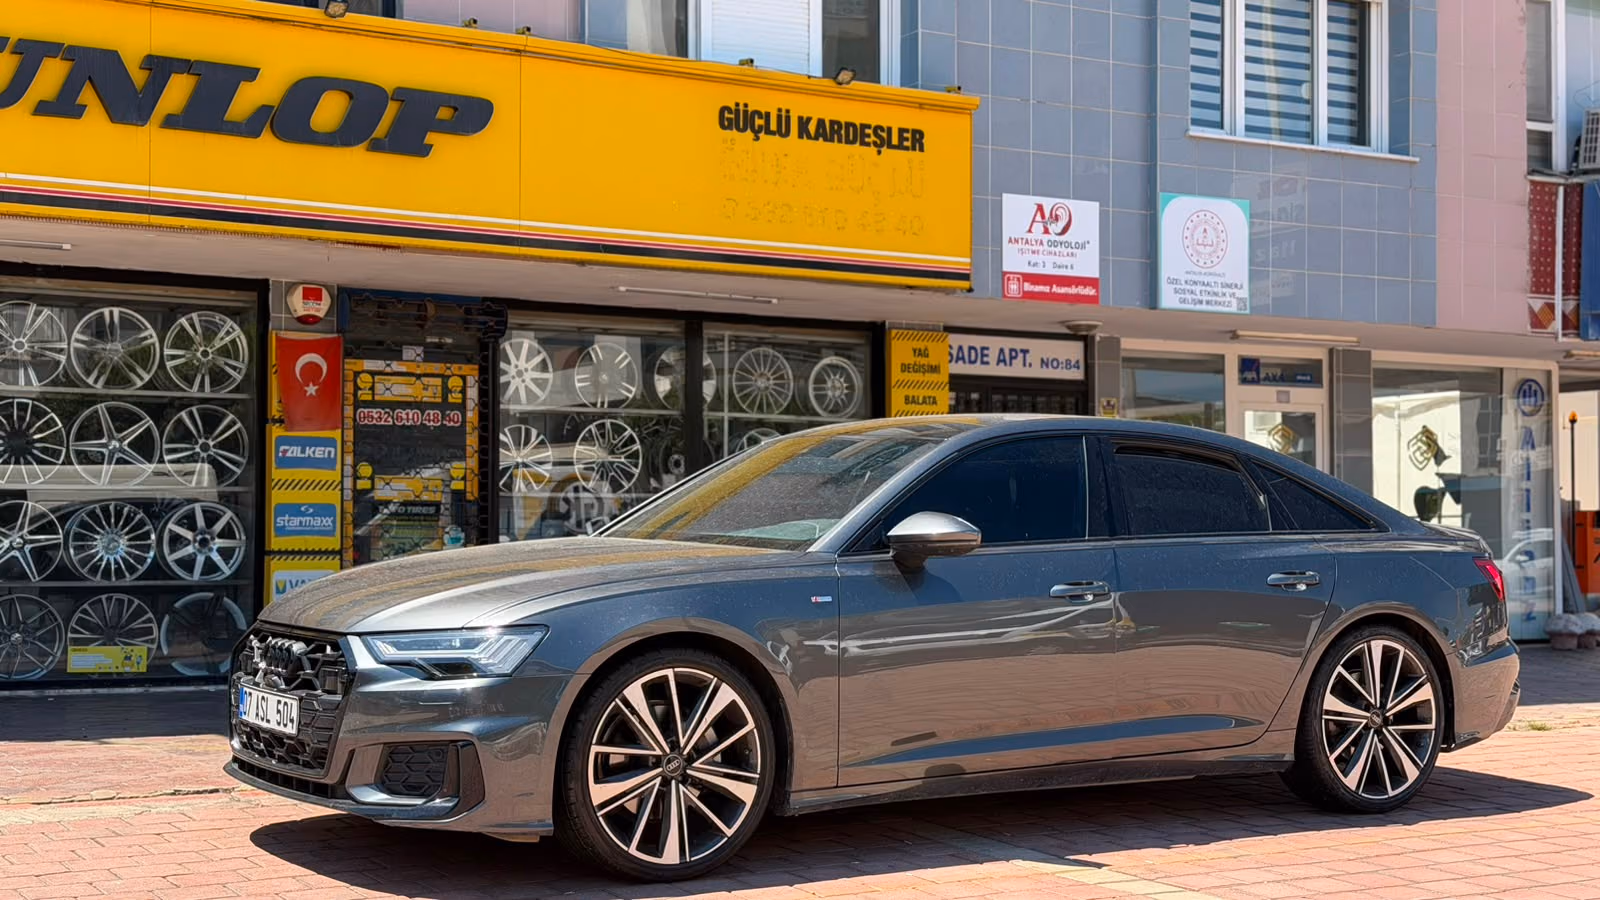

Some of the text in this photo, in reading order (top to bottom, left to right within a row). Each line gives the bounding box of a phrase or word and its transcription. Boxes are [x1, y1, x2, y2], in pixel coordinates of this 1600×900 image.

[718, 102, 925, 155] GÜÇLÜ KARDEŞLER
[1008, 237, 1044, 248] ANTALYA
[1166, 276, 1244, 290] ÖZEL KONYAALTI SİNERJİ
[1173, 287, 1198, 296] SOSYAL
[1199, 288, 1227, 298] ETKİNLİK
[1178, 297, 1204, 306] GELİŞİM
[912, 345, 930, 358] YAĞ
[996, 347, 1033, 368] APT.
[1040, 357, 1081, 371] NO:84
[900, 360, 941, 377] DEĞİŞİMİ
[904, 394, 938, 406] BALATA
[357, 408, 393, 425] 0532
[394, 409, 421, 426] 610
[423, 410, 441, 427] 48
[279, 445, 335, 459] FALKEN
[276, 513, 334, 527] starmaxx
[243, 690, 295, 730] 07 ASL 504
